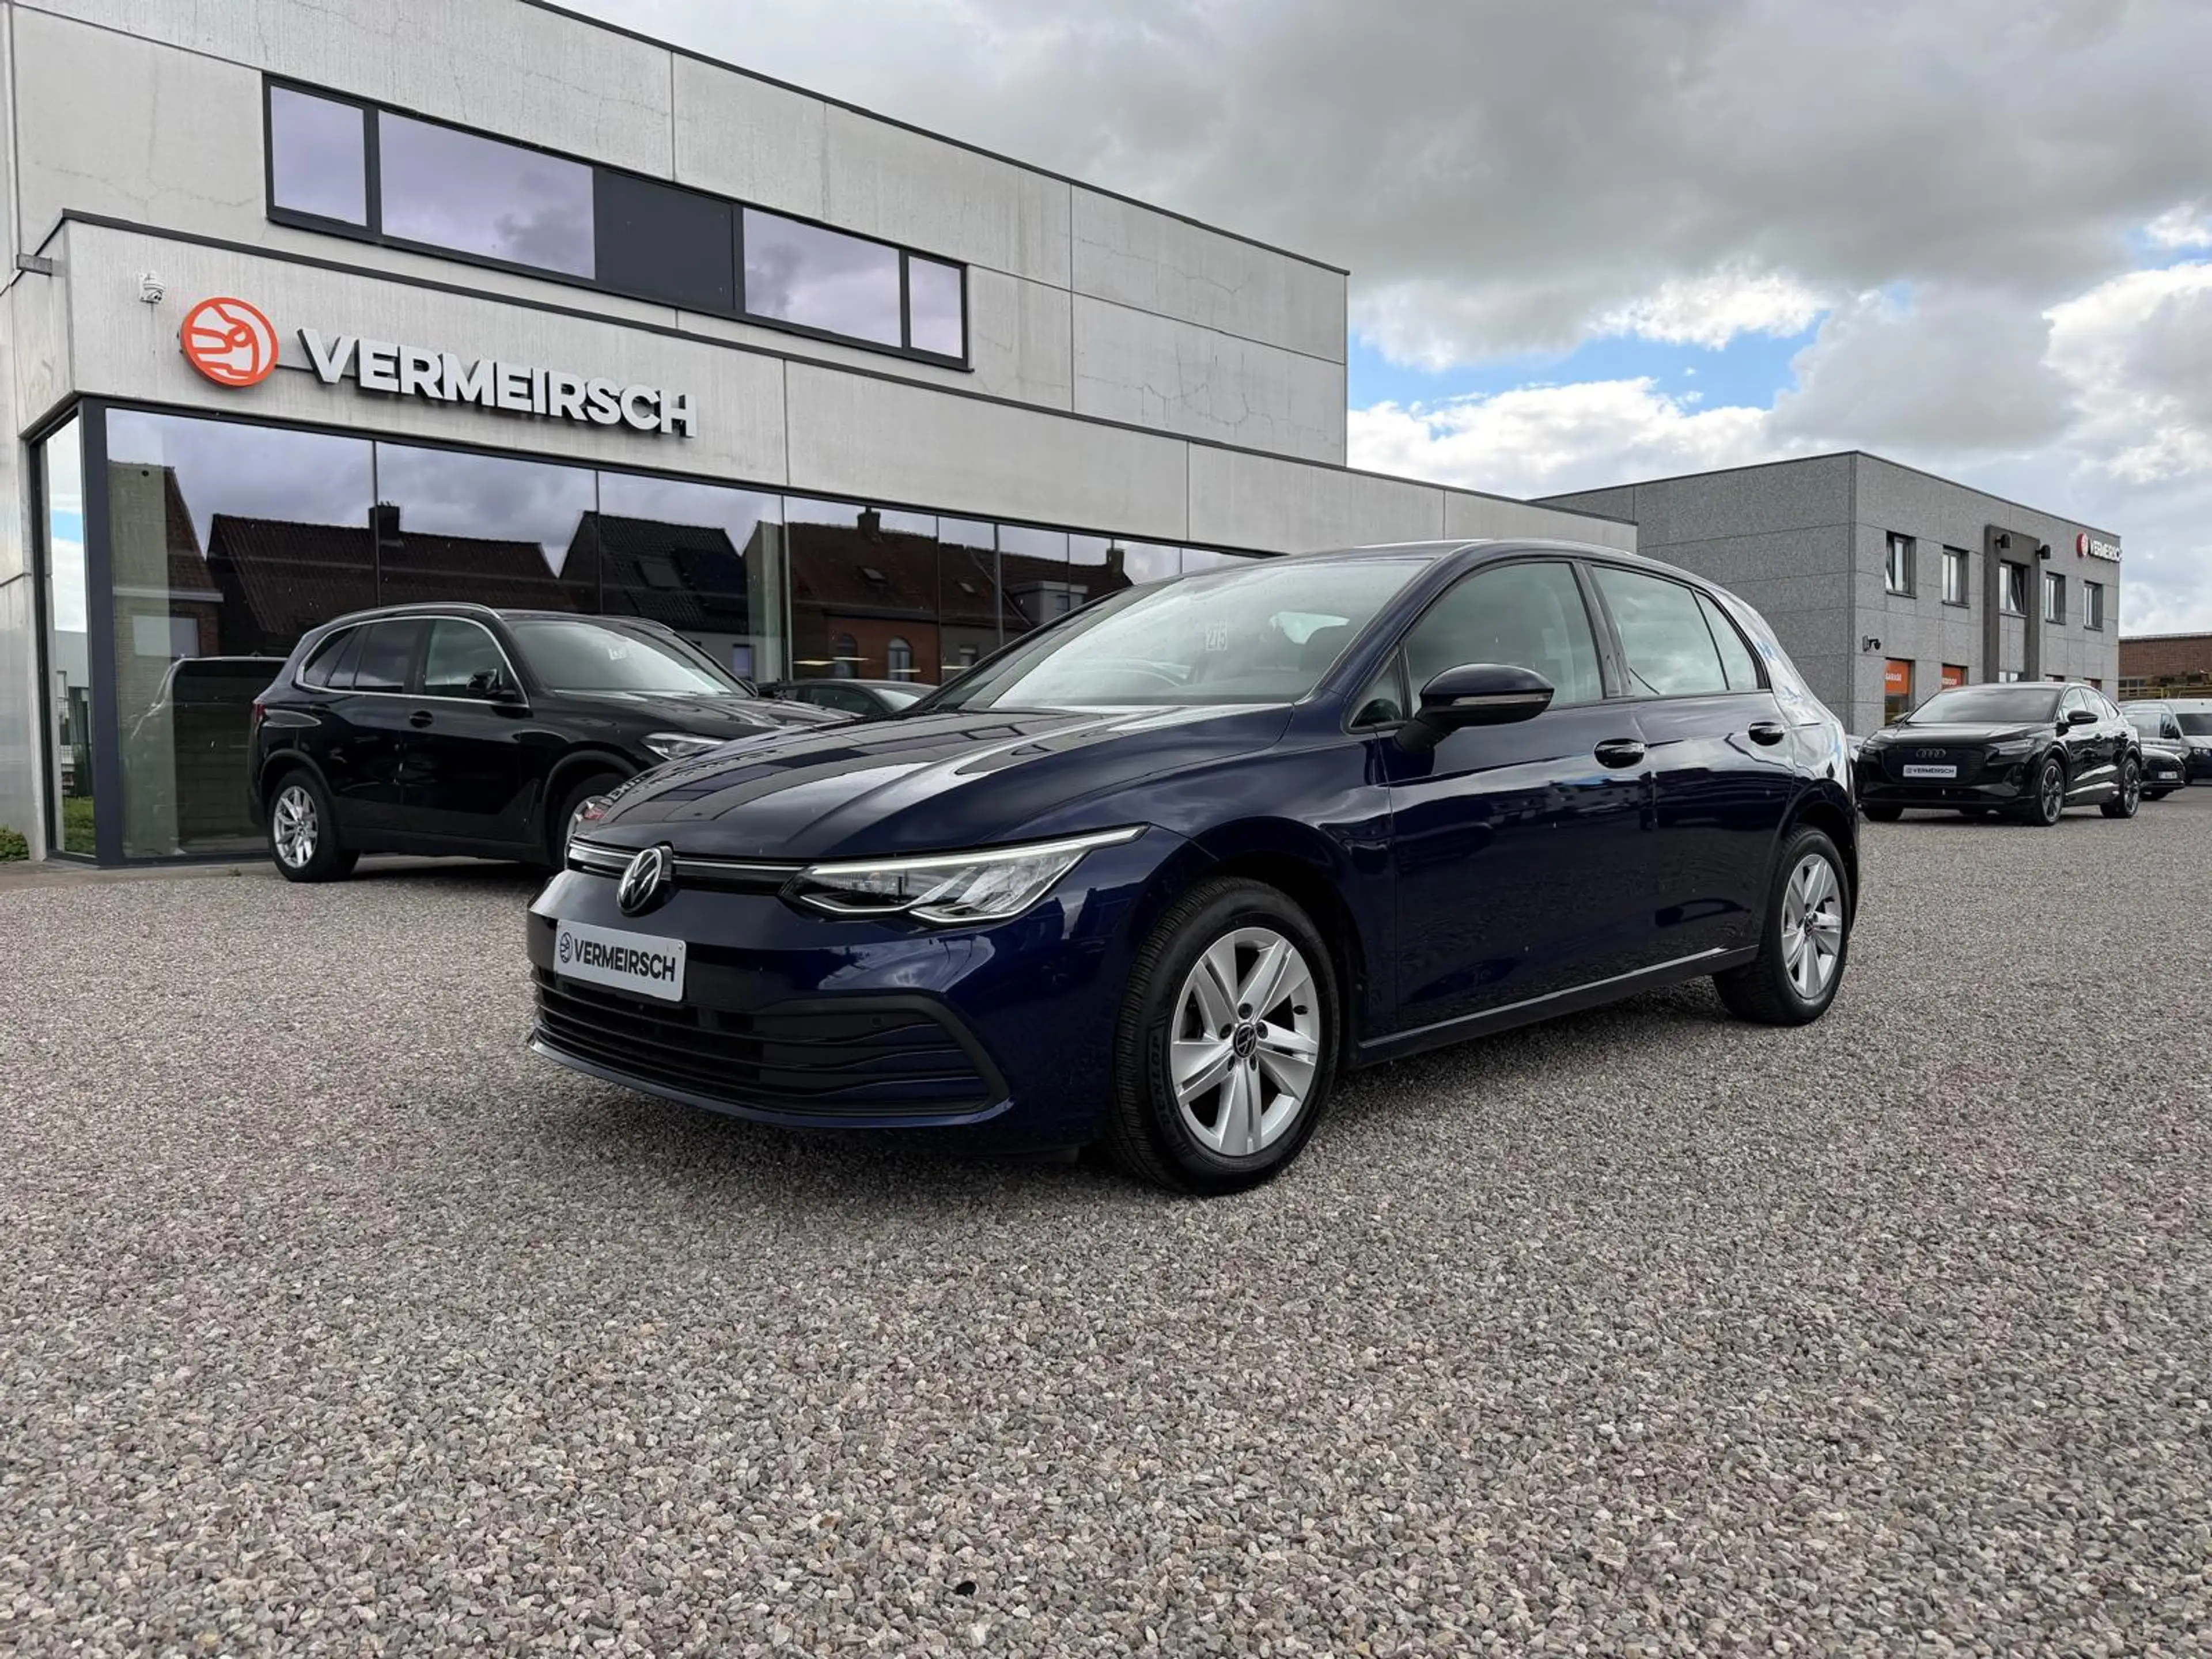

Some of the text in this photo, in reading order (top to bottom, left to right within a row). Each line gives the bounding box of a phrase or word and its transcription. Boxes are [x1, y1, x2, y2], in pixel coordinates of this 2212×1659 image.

[297, 327, 696, 437] VERMEIRSCH
[574, 938, 676, 982] VERMEIRSCH
[1152, 1036, 1171, 1124] DUNLOP
